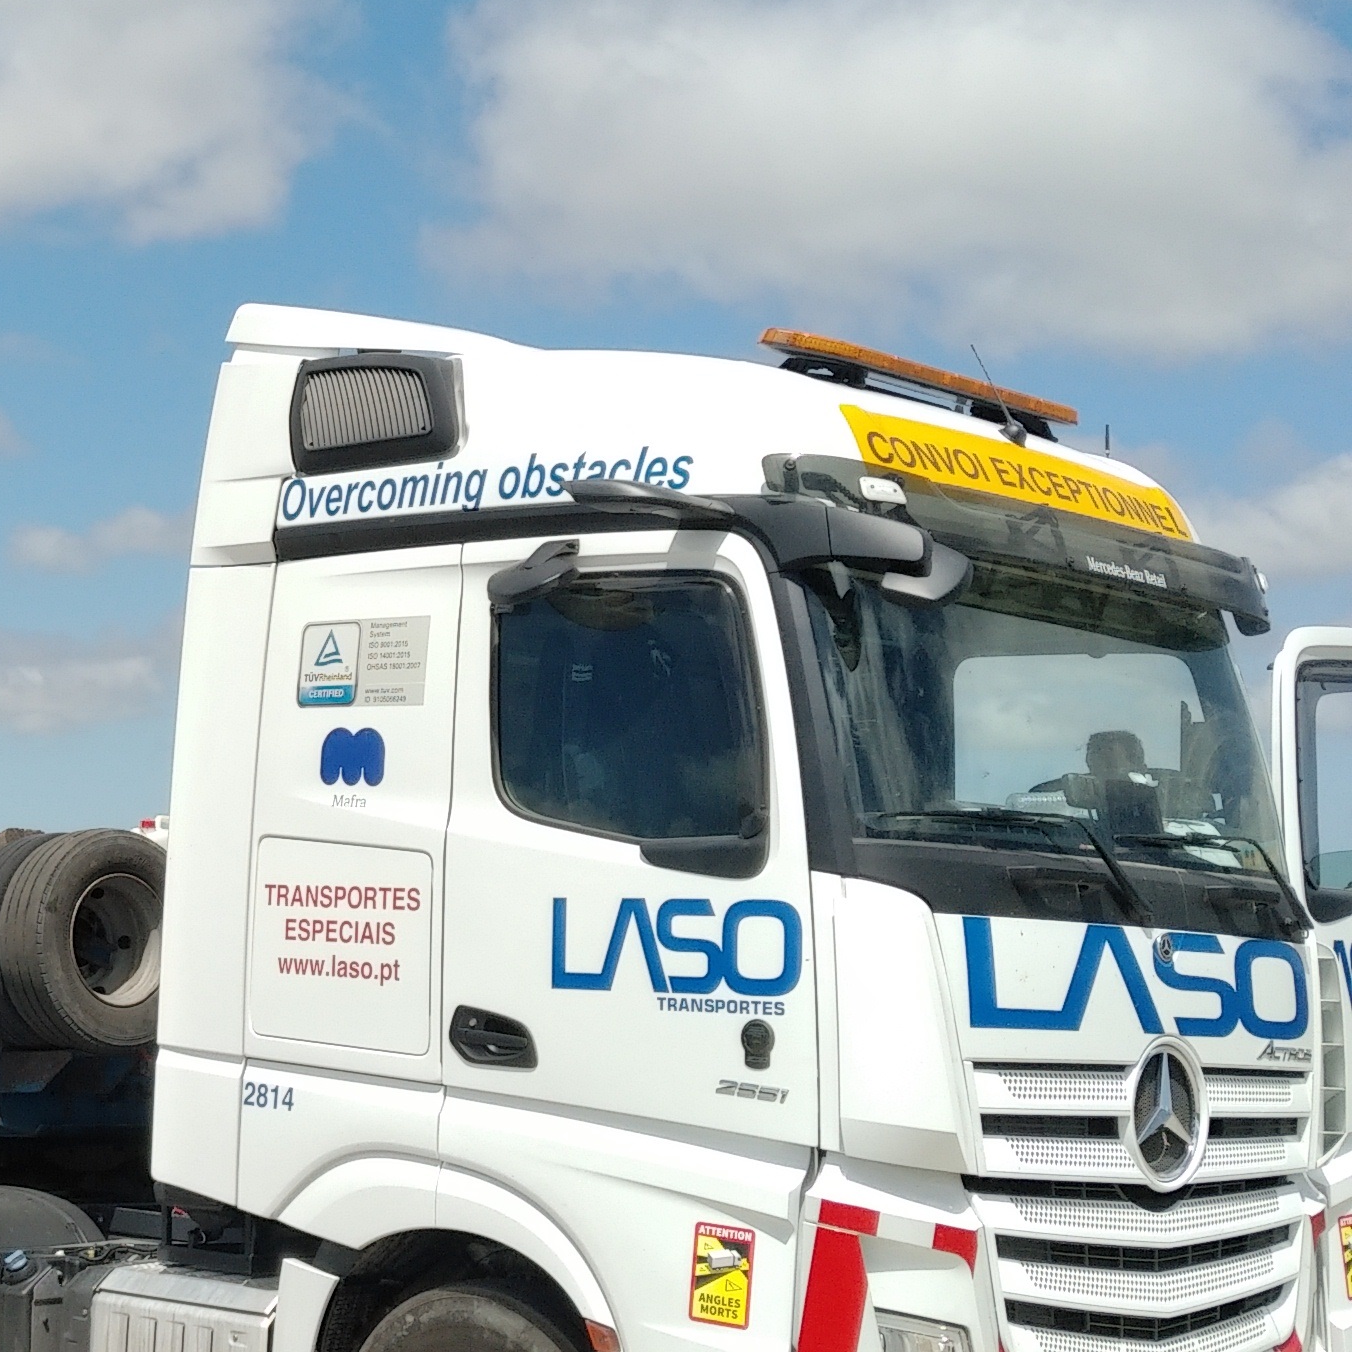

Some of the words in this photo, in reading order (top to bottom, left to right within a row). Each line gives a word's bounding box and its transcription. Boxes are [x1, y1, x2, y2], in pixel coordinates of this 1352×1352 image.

[282, 461, 488, 521] Overcoming
[498, 446, 694, 501] obstacles
[867, 431, 989, 482] CONVOI
[989, 456, 1189, 538] EXCEPTIONNEL
[371, 621, 408, 629] Management
[369, 631, 391, 639] System
[380, 640, 409, 648] 9001:2015
[367, 652, 379, 660] ISO
[380, 651, 411, 659] 14001:2015
[366, 663, 388, 671] OHSAS
[308, 688, 345, 698] CERTIFIED
[332, 794, 367, 808] Mafra
[265, 883, 421, 912] TRANSPORTES
[285, 918, 396, 946] ESPECIAIS
[551, 896, 803, 997] LASO
[278, 955, 401, 986] www.laso.pt
[962, 915, 1309, 1040] LASO
[657, 997, 786, 1016] TRANSPORTES
[243, 1081, 295, 1112] 2814
[715, 1079, 790, 1105] 2551
[698, 1224, 753, 1242] ATTENTION
[698, 1292, 741, 1309] ANGLES
[700, 1303, 738, 1320] MORTS
